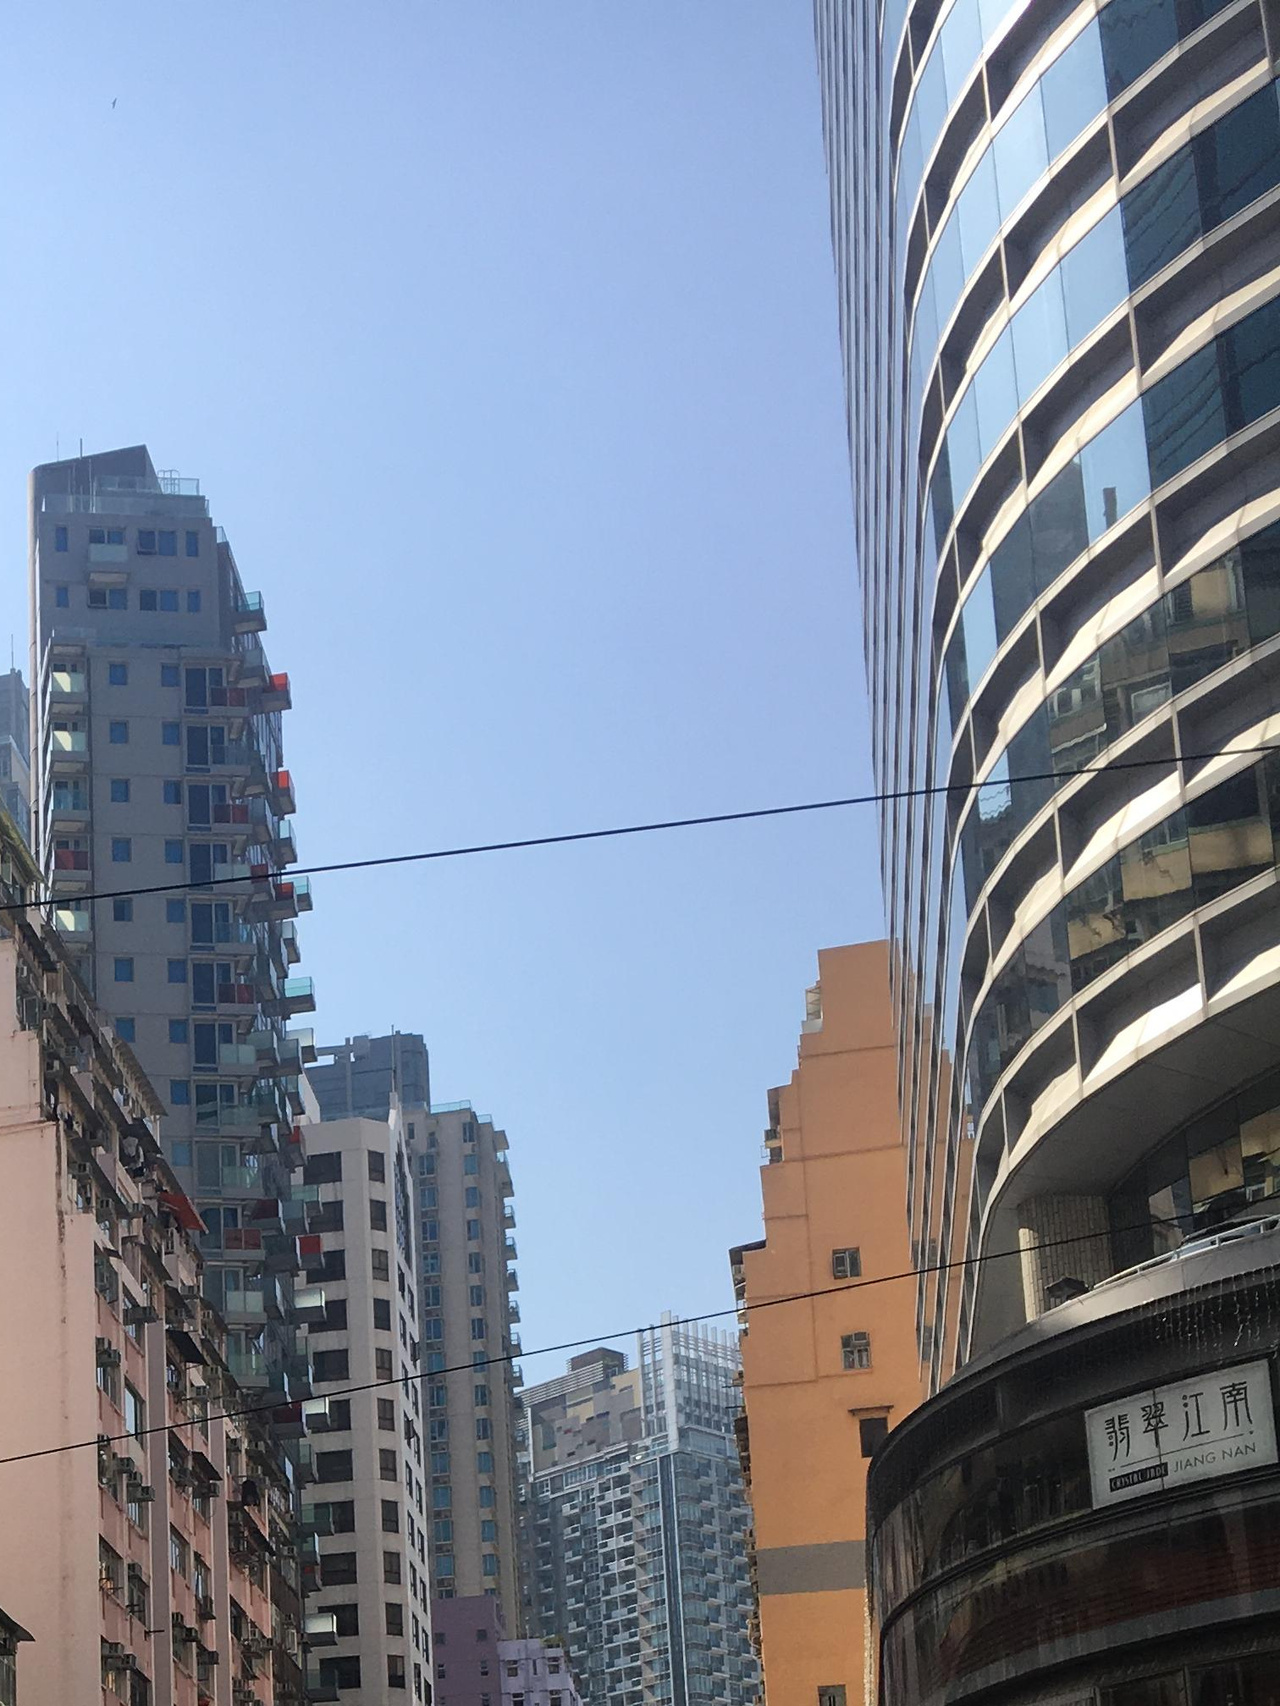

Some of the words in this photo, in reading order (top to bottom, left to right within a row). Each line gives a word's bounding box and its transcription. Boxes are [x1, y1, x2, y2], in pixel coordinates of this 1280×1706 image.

[1104, 1380, 1253, 1462] 翡翠江南
[1173, 1452, 1217, 1474] JIANG
[1221, 1443, 1257, 1461] NAN
